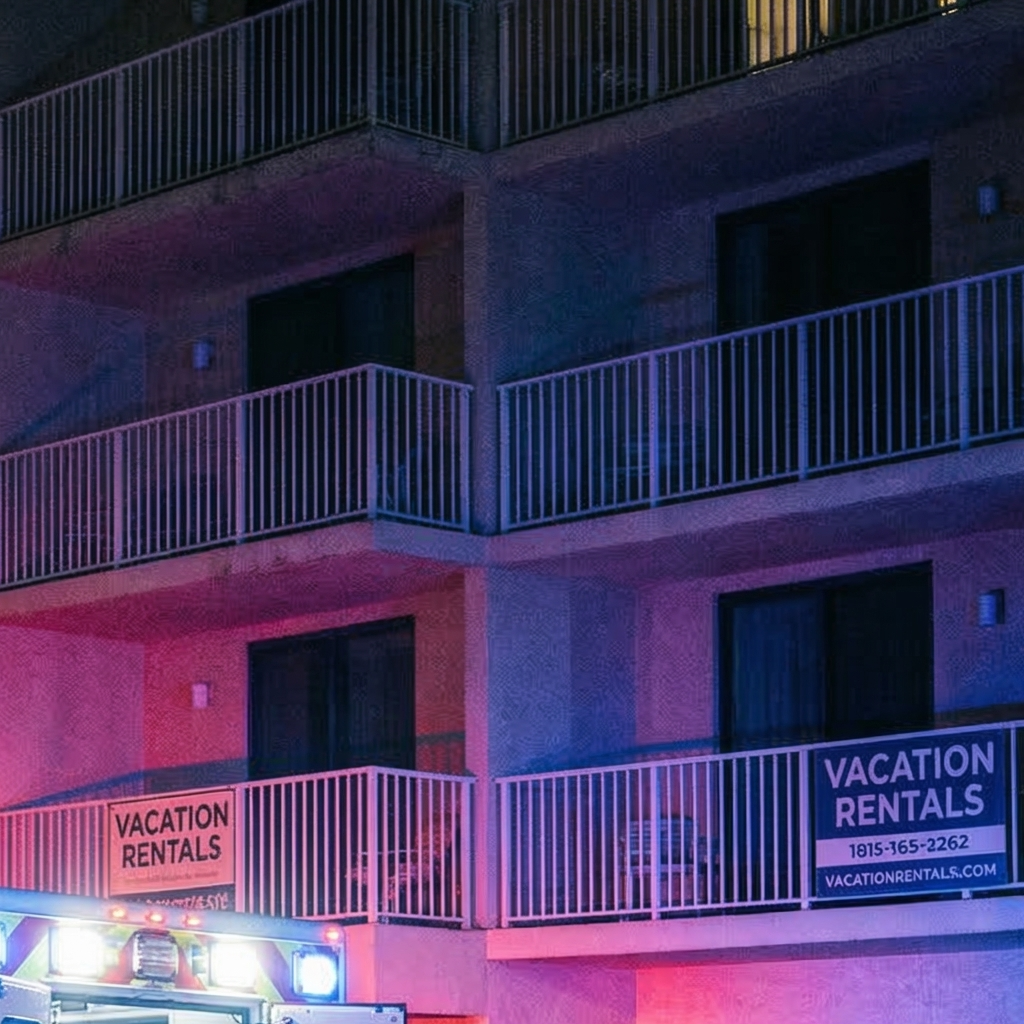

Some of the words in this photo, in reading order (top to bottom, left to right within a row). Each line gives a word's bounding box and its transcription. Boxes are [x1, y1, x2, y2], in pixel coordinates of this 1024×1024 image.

[824, 741, 995, 789] VACATION
[115, 800, 229, 839] VACATION
[835, 783, 985, 828] RENTALS
[122, 834, 222, 869] RENTALS
[825, 863, 997, 888] VACATIONRENTALS.COM
